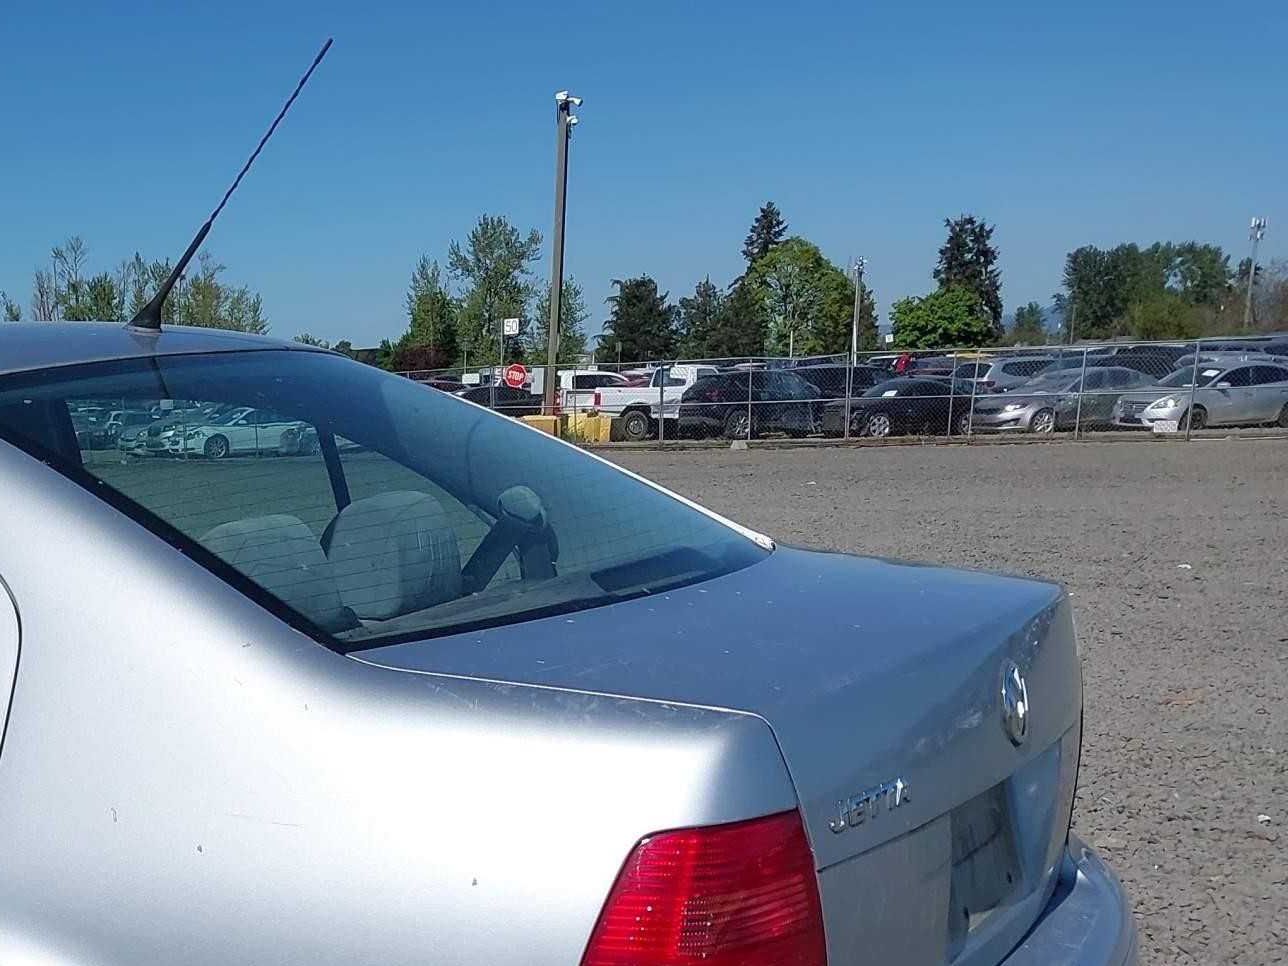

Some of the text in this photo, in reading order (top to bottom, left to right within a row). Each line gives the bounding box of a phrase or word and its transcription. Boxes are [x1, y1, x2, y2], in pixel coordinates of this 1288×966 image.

[505, 320, 518, 333] 50
[508, 370, 524, 381] STOP
[829, 775, 911, 834] JETTA
